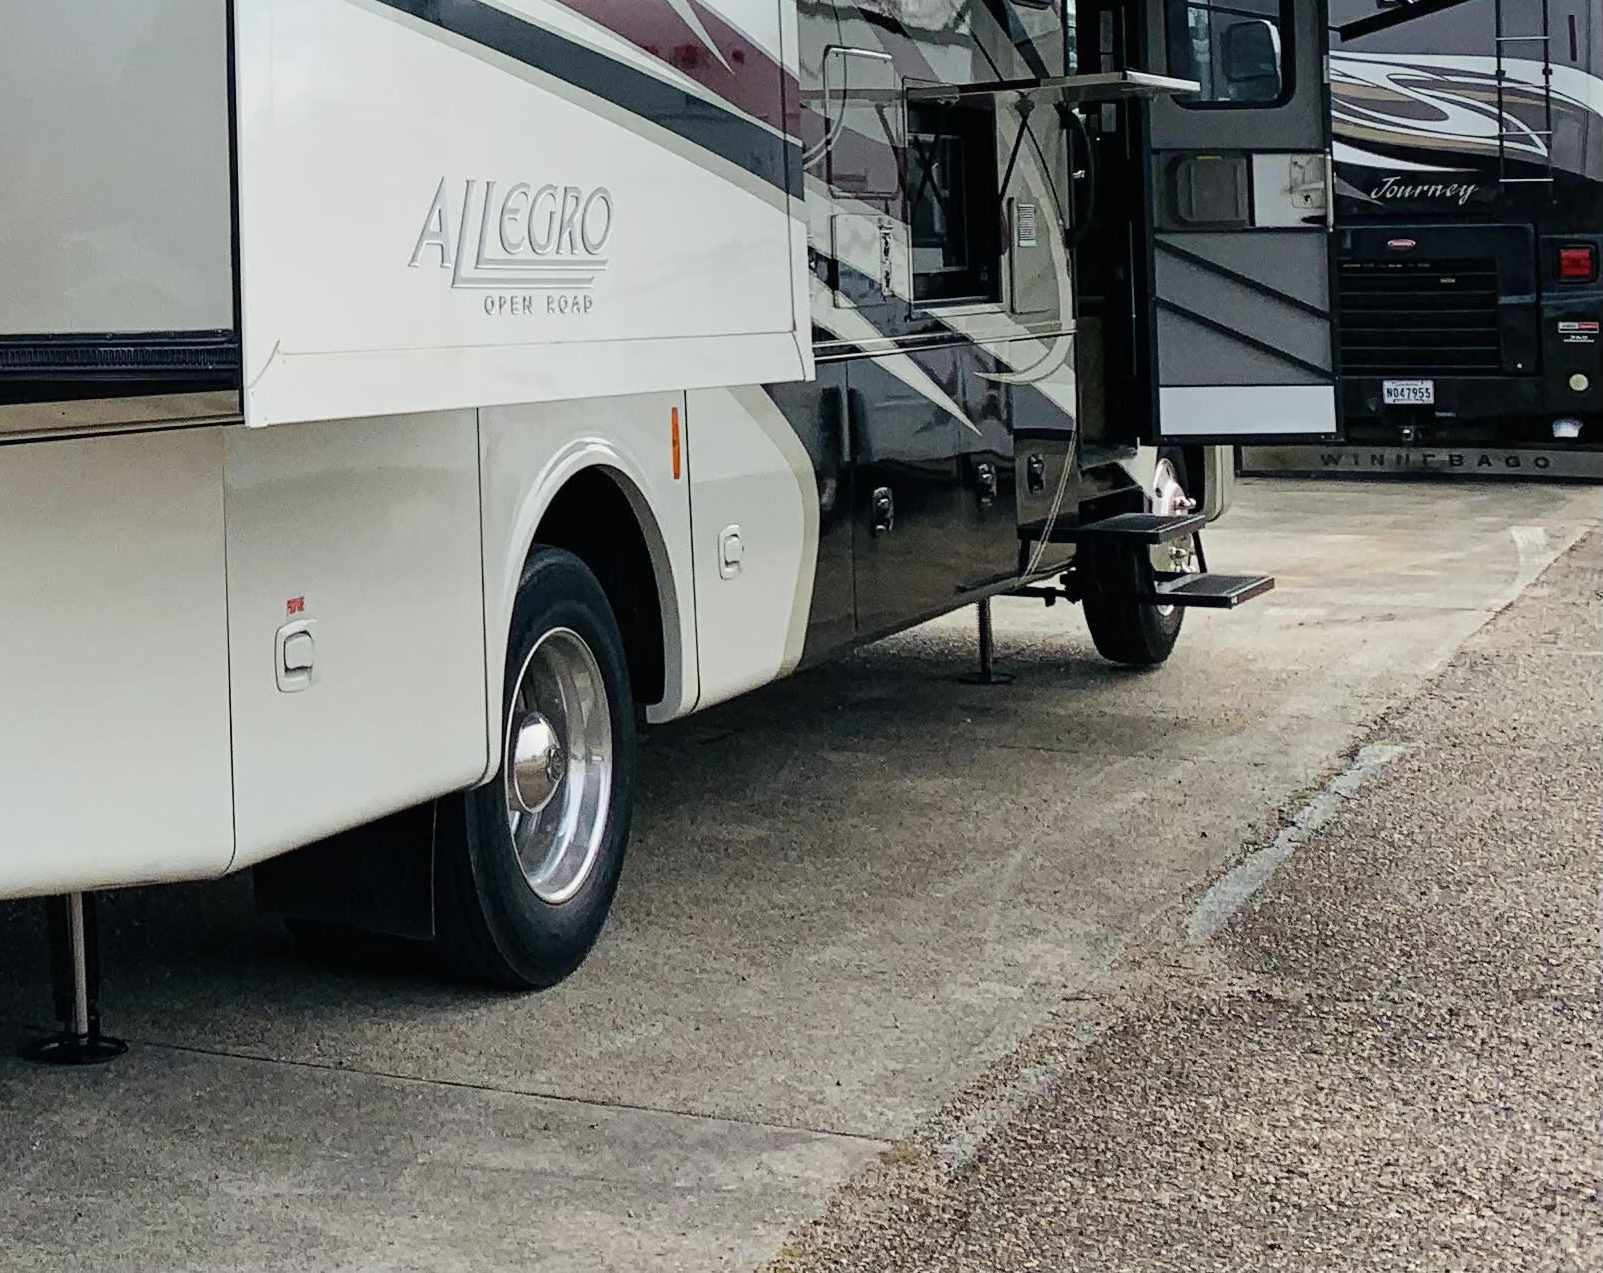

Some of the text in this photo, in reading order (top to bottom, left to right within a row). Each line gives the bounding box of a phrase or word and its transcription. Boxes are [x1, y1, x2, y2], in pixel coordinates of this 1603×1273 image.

[1370, 176, 1479, 206] Journey
[407, 175, 614, 289] ALLEGRO
[484, 294, 594, 316] OPEN ROAD
[1320, 452, 1550, 470] WINNEBAGO
